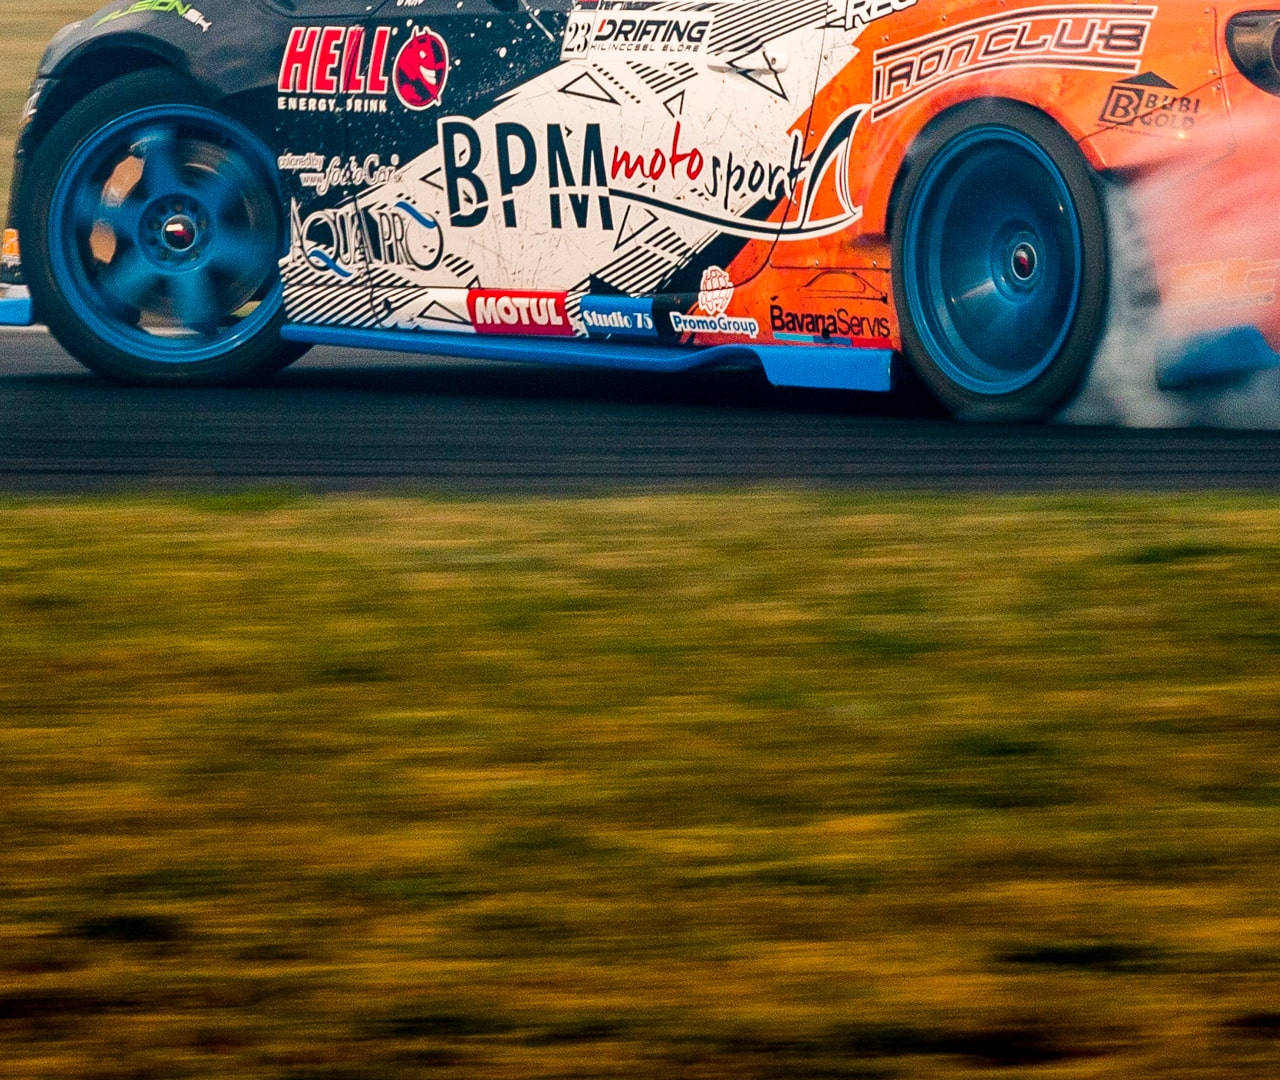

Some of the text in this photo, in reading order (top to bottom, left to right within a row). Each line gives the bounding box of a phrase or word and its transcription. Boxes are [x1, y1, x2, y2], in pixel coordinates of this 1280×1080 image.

[564, 22, 591, 52] 23
[594, 19, 710, 42] DRIFTING
[979, 19, 1150, 60] CLUB
[278, 25, 392, 94] HELL
[278, 96, 336, 112] ENERGY
[442, 121, 614, 230] BPM
[475, 296, 564, 326] MOTUL
[582, 309, 654, 329] Studio 75
[672, 314, 758, 336] PromoGroup
